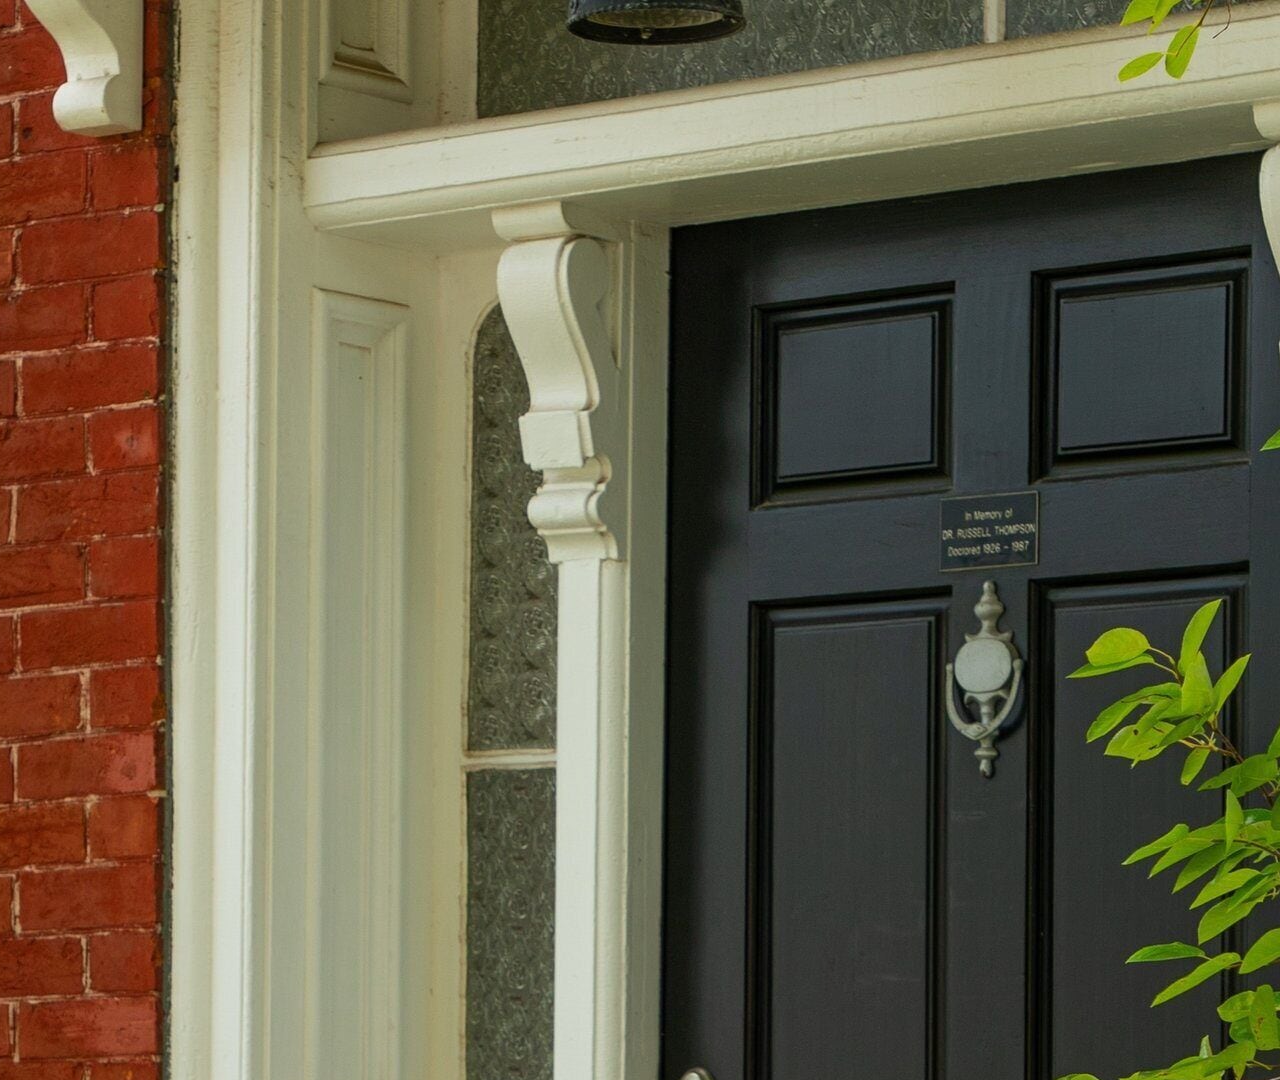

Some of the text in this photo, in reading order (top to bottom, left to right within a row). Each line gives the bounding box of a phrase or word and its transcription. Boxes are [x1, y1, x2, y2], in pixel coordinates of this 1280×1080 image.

[973, 510, 1002, 521] Memory
[1004, 508, 1013, 519] of
[957, 526, 992, 540] RUSSELL
[994, 523, 1035, 536] THOMPSON
